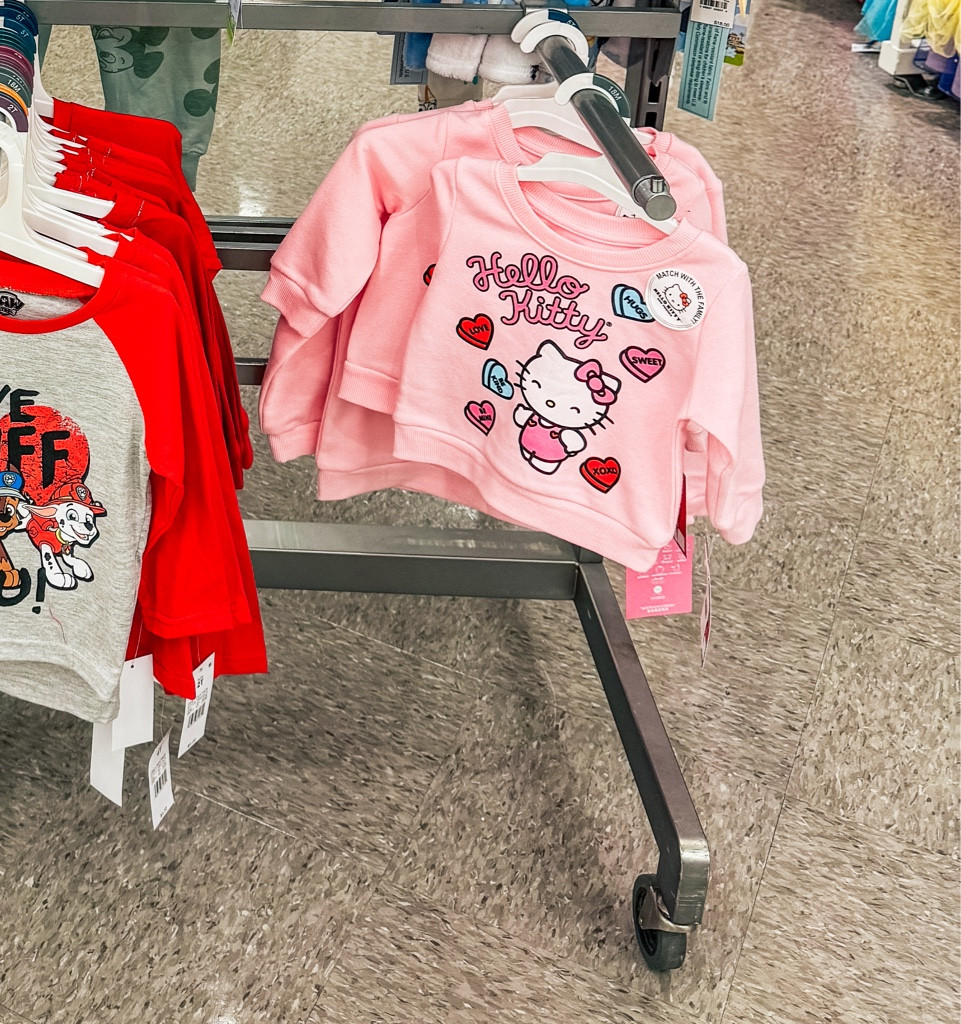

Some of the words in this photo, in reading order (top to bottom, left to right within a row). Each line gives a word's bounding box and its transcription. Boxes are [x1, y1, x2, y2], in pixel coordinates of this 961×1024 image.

[7, 79, 22, 93] 18M
[607, 85, 623, 101] 18M
[6, 104, 18, 113] 2T
[466, 251, 590, 298] Hello
[655, 270, 679, 280] MATCH
[680, 272, 697, 288] WITH
[694, 285, 704, 300] THE
[623, 295, 648, 319] HUGS
[498, 289, 608, 350] Kitty
[468, 323, 490, 335] LOVE
[631, 356, 663, 366] SWEET
[592, 466, 618, 477] XOXO
